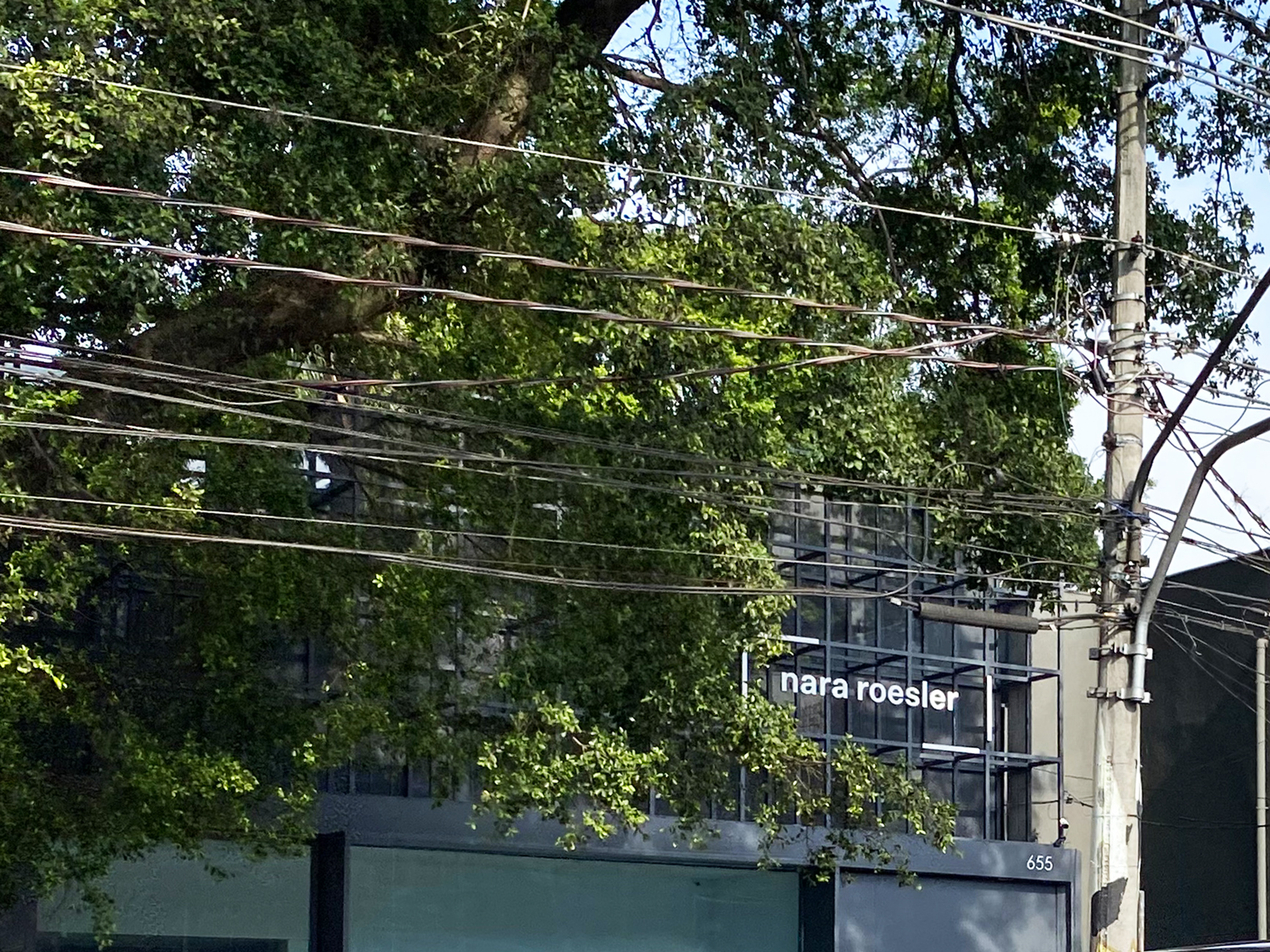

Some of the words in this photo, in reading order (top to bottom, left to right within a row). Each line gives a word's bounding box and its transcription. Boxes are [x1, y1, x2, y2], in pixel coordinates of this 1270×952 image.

[781, 671, 849, 700] nara
[857, 680, 960, 712] roesler
[1026, 854, 1054, 871] 655
